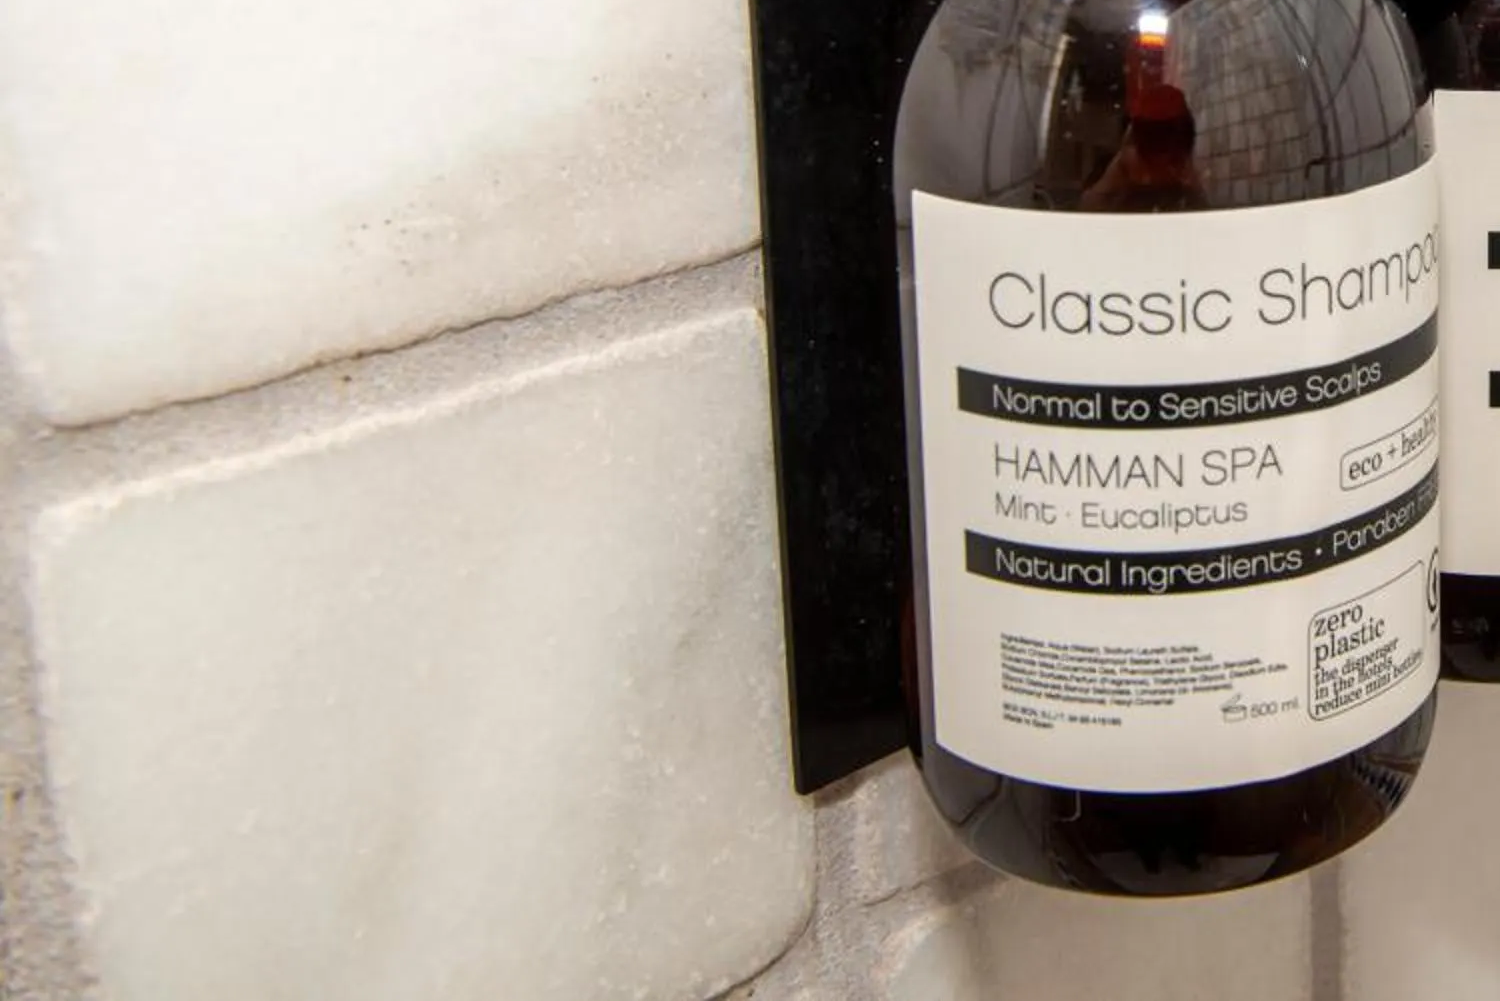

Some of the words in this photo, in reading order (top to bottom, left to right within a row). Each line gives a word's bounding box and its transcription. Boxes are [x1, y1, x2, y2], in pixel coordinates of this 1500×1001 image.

[989, 272, 1232, 336] Classic
[1258, 224, 1438, 325] Shampo
[993, 384, 1101, 421] Normal
[1112, 397, 1150, 420] to
[1159, 385, 1297, 420] Sensitive
[1306, 360, 1382, 400] Scalps
[994, 443, 1183, 488] HAMMAN
[1201, 443, 1283, 486] SPA
[1349, 452, 1383, 481] eco
[995, 493, 1057, 524] Mint
[1081, 499, 1248, 534] Eucaliptus
[995, 548, 1110, 587] Natural
[1121, 545, 1303, 593] Ingredients
[1333, 500, 1416, 556] Paraben
[1314, 603, 1363, 638] zero
[1314, 617, 1386, 670] plastic
[1315, 666, 1339, 687] the
[1315, 684, 1329, 701] in
[1333, 675, 1355, 698] the
[1315, 688, 1363, 716] reduce
